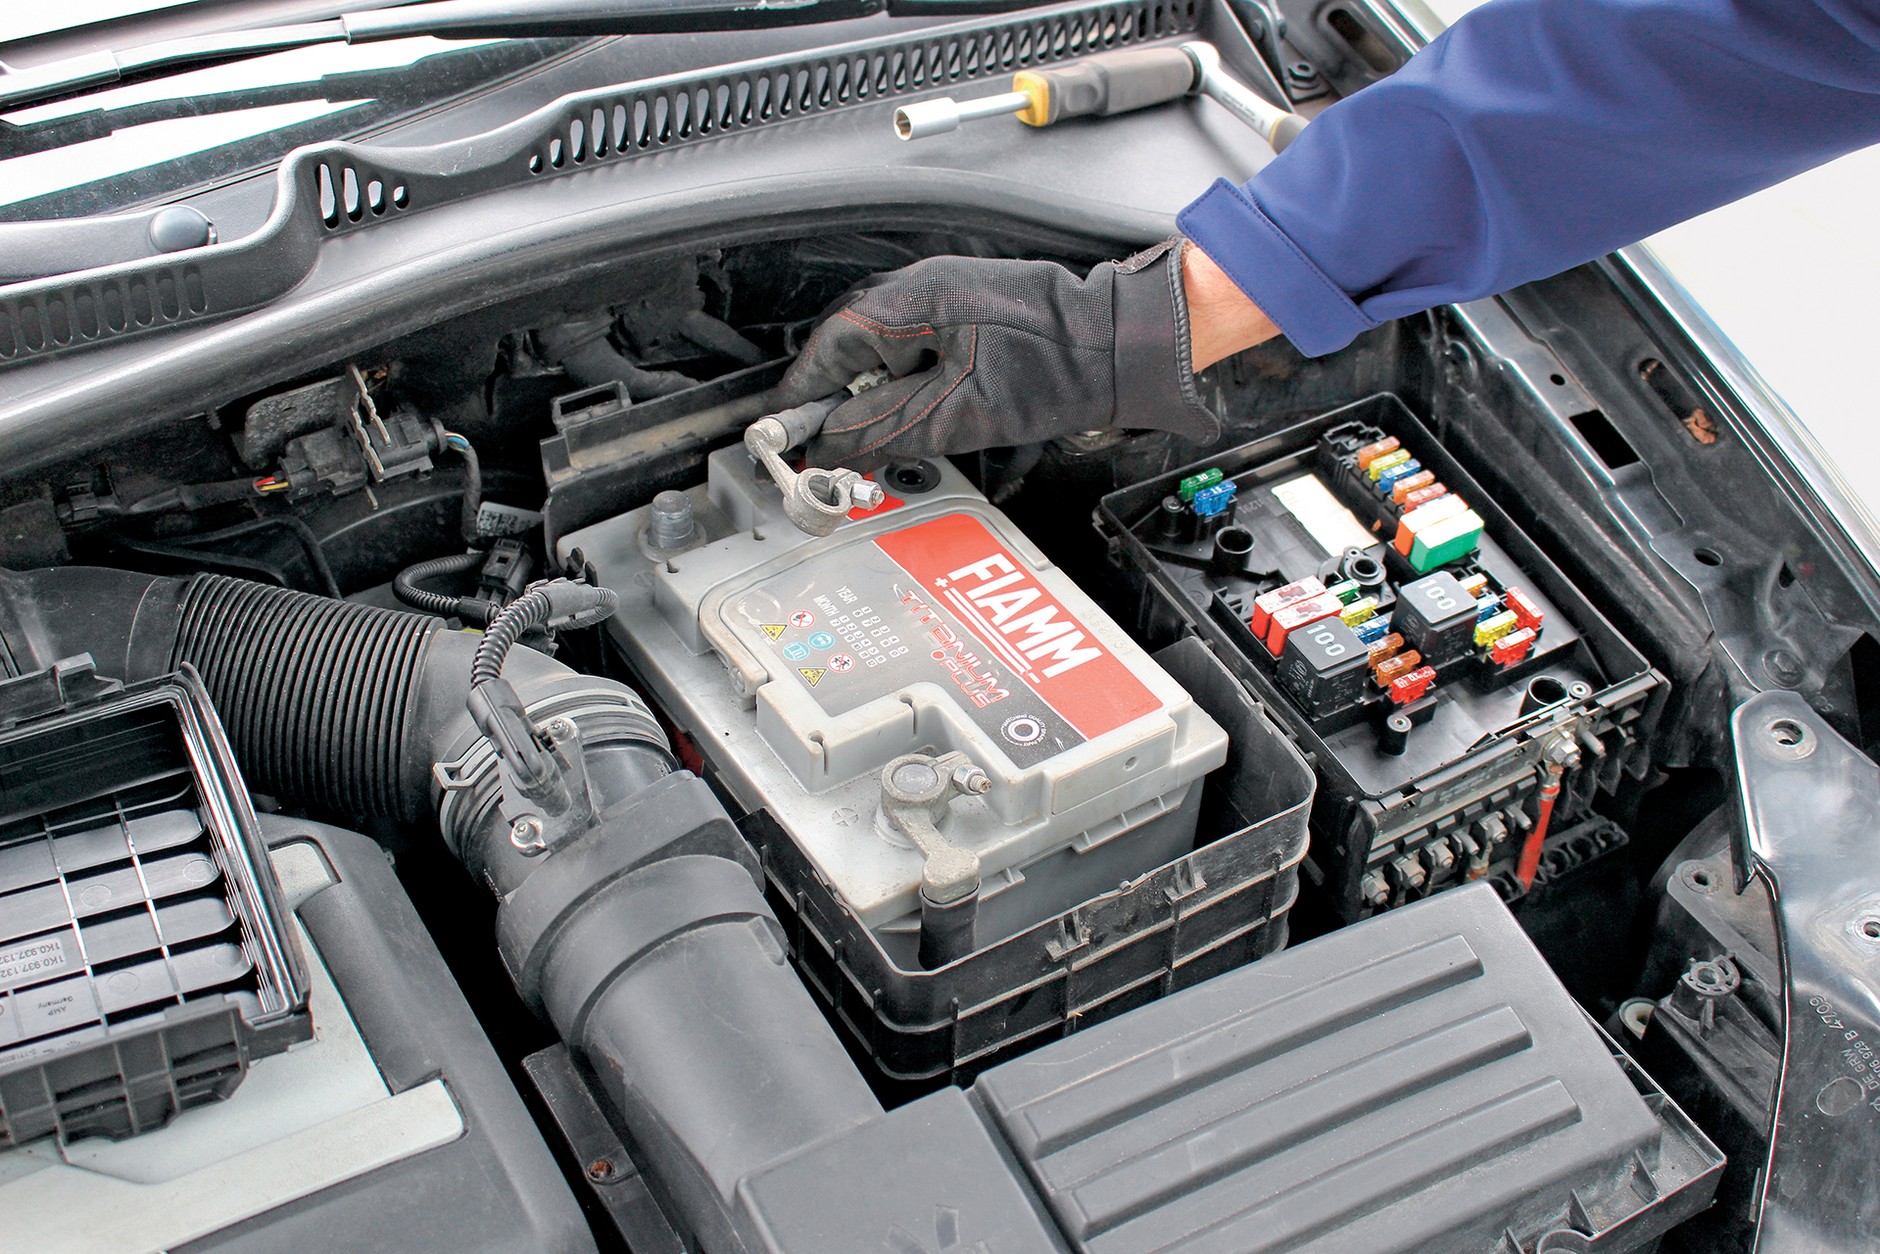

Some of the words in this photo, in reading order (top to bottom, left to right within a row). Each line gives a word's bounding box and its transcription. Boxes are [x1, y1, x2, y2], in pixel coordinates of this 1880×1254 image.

[813, 594, 839, 618] MONTH
[835, 585, 858, 605] YEAR
[1418, 578, 1456, 610] 100
[947, 553, 1103, 679] FIAMM
[1306, 624, 1345, 657] 100
[938, 657, 992, 709] PLUS
[38, 995, 74, 1009] Germany
[1809, 993, 1845, 1030] 4709
[1844, 1029, 1859, 1041] B
[1841, 1048, 1866, 1073] GRW
[1854, 1040, 1873, 1059] 929
[1862, 1073, 1880, 1090] DE
